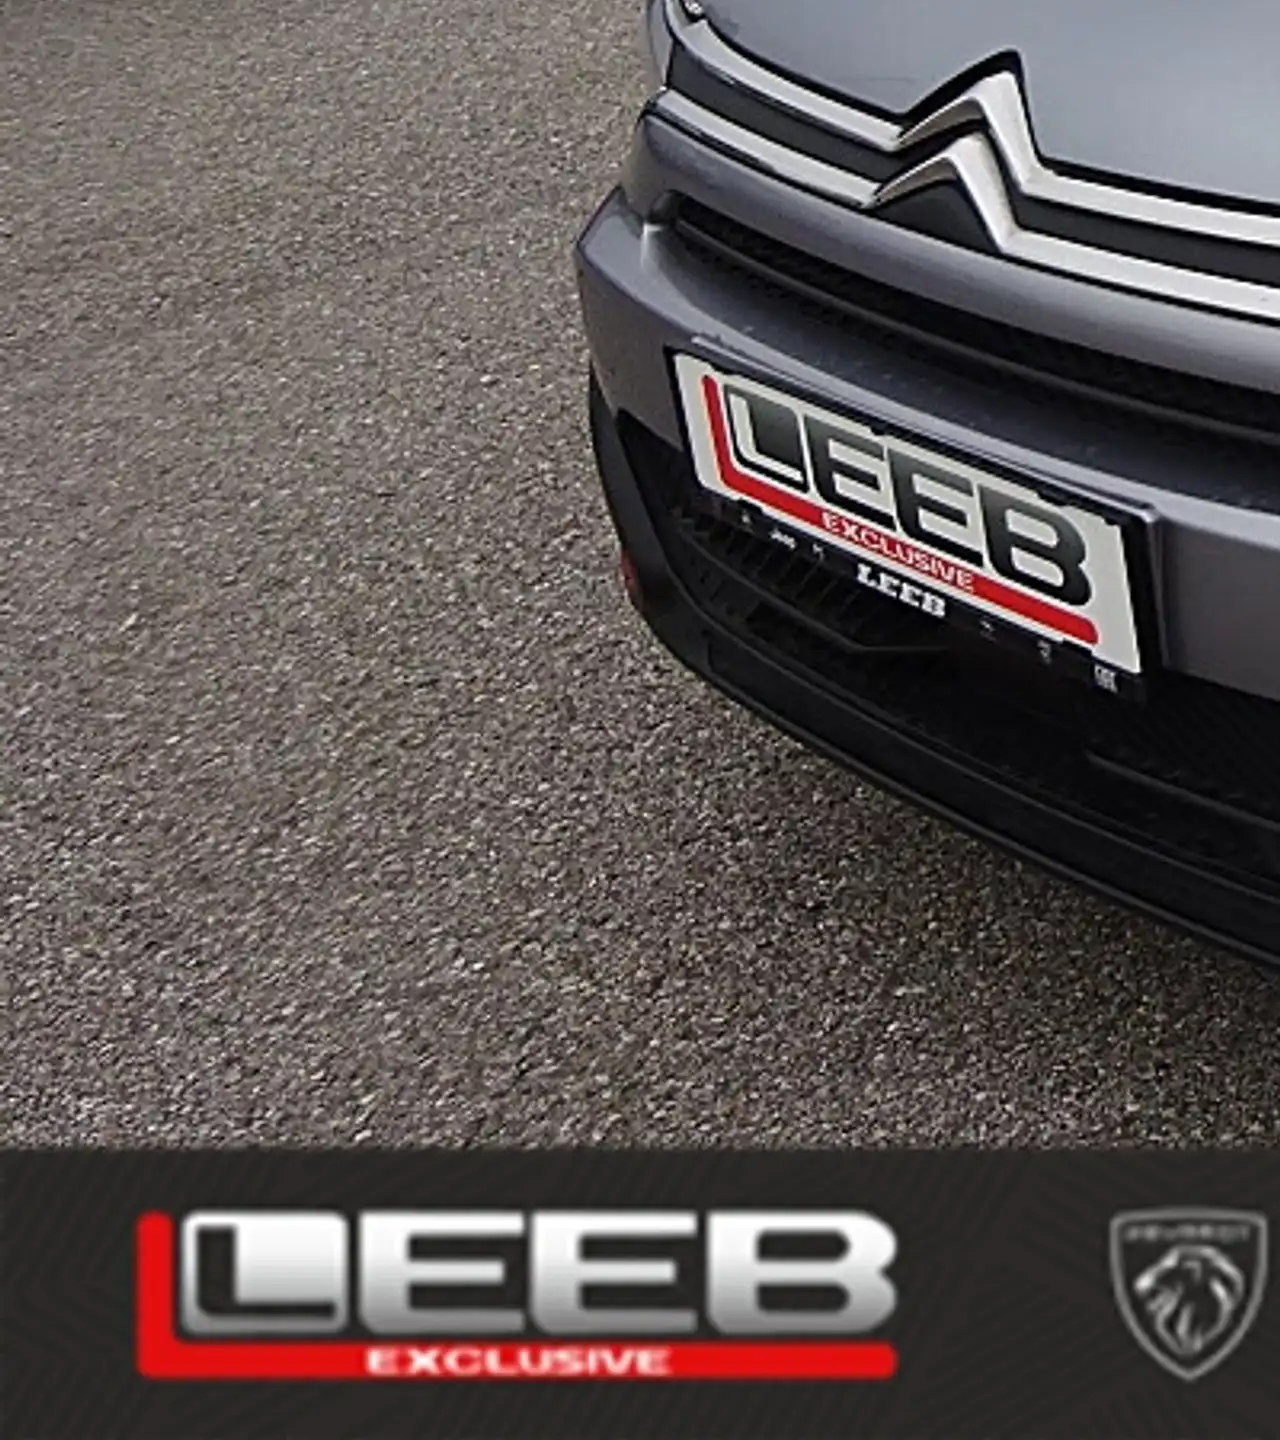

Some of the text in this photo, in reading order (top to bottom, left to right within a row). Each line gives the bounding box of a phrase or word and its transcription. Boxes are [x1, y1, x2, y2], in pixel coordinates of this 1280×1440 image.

[722, 382, 1093, 608] LEEB
[818, 511, 977, 594] EXCLUSIVE
[856, 564, 946, 619] LEEB
